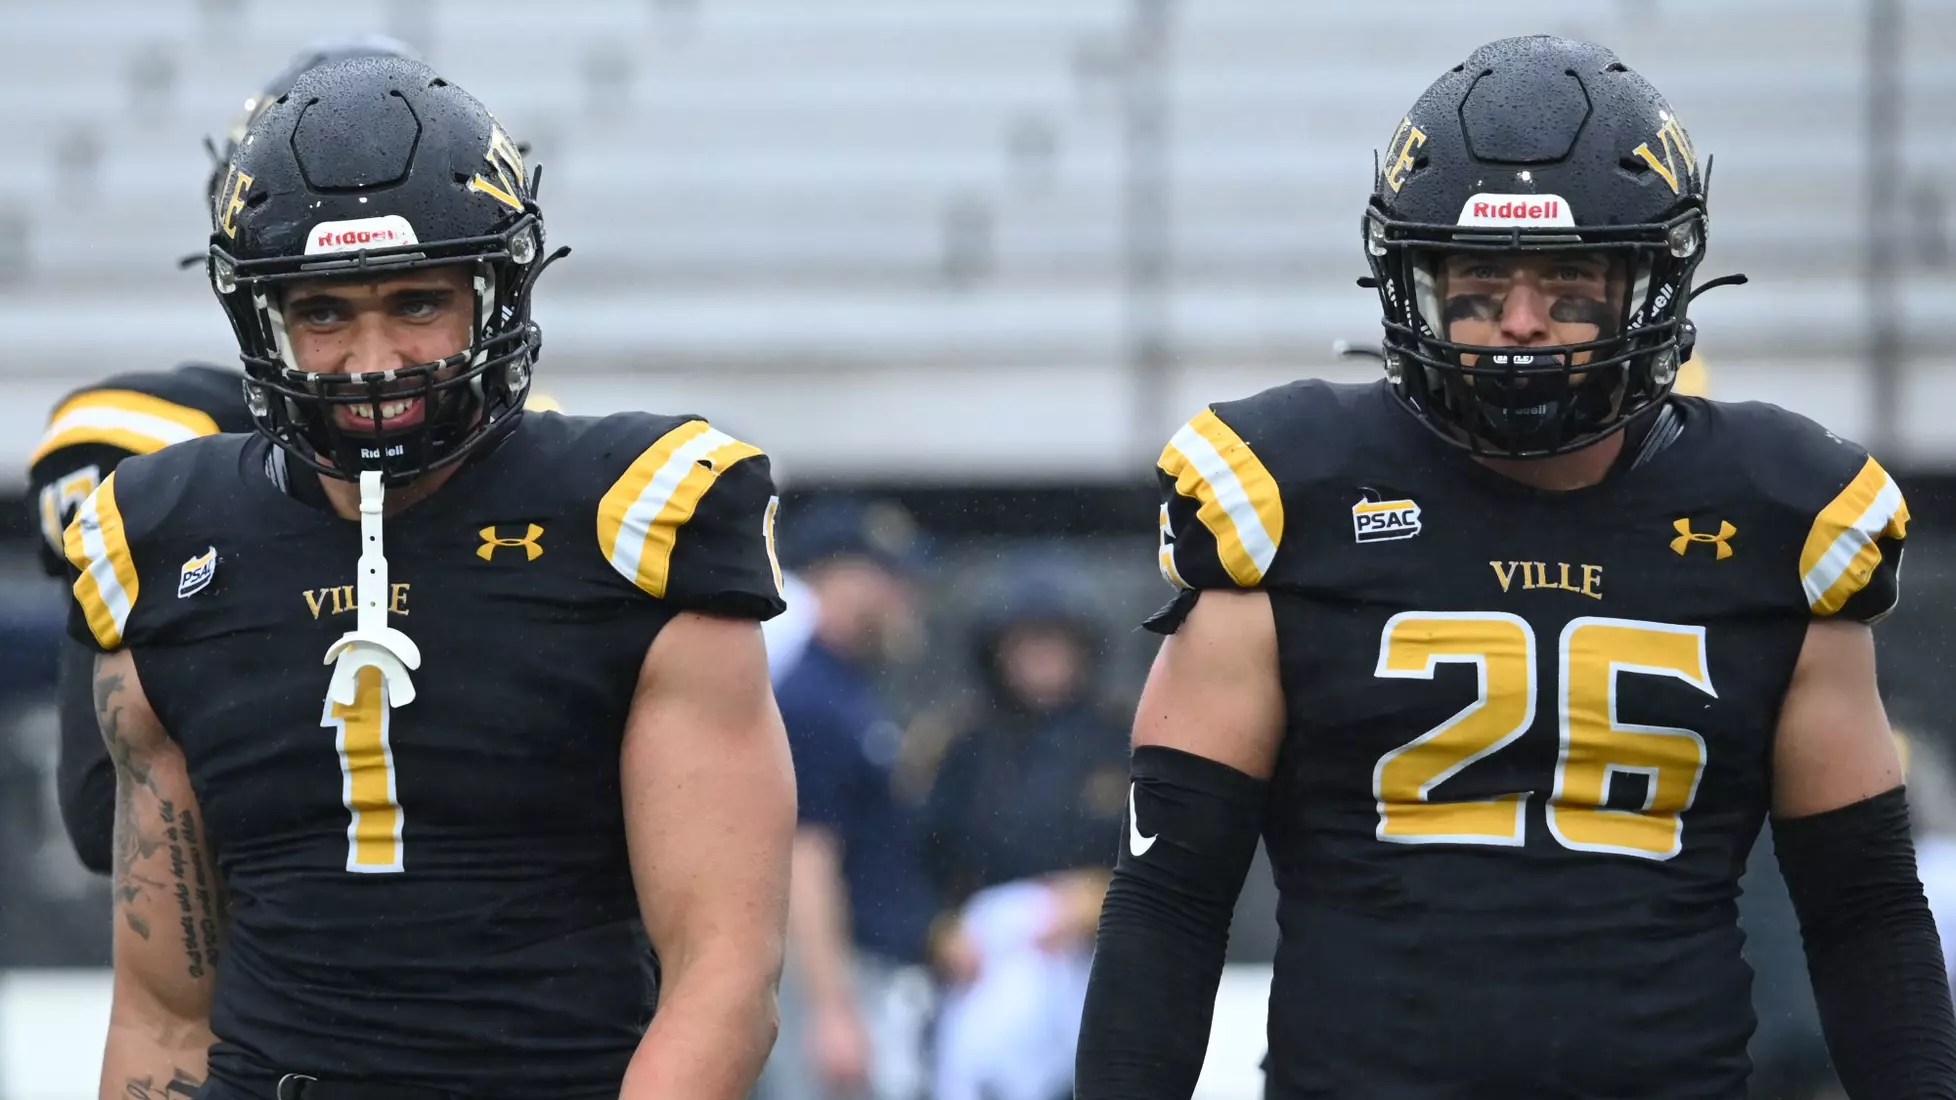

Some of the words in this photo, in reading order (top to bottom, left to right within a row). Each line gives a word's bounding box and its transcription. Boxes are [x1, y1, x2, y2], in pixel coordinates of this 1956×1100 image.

[1473, 201, 1559, 219] Riddell
[318, 230, 400, 247] Riddel
[1357, 509, 1416, 531] PSAC
[1489, 560, 1603, 600] VILLE
[302, 583, 411, 620] VILE
[1373, 611, 1719, 862] 26
[319, 664, 405, 873] 1
